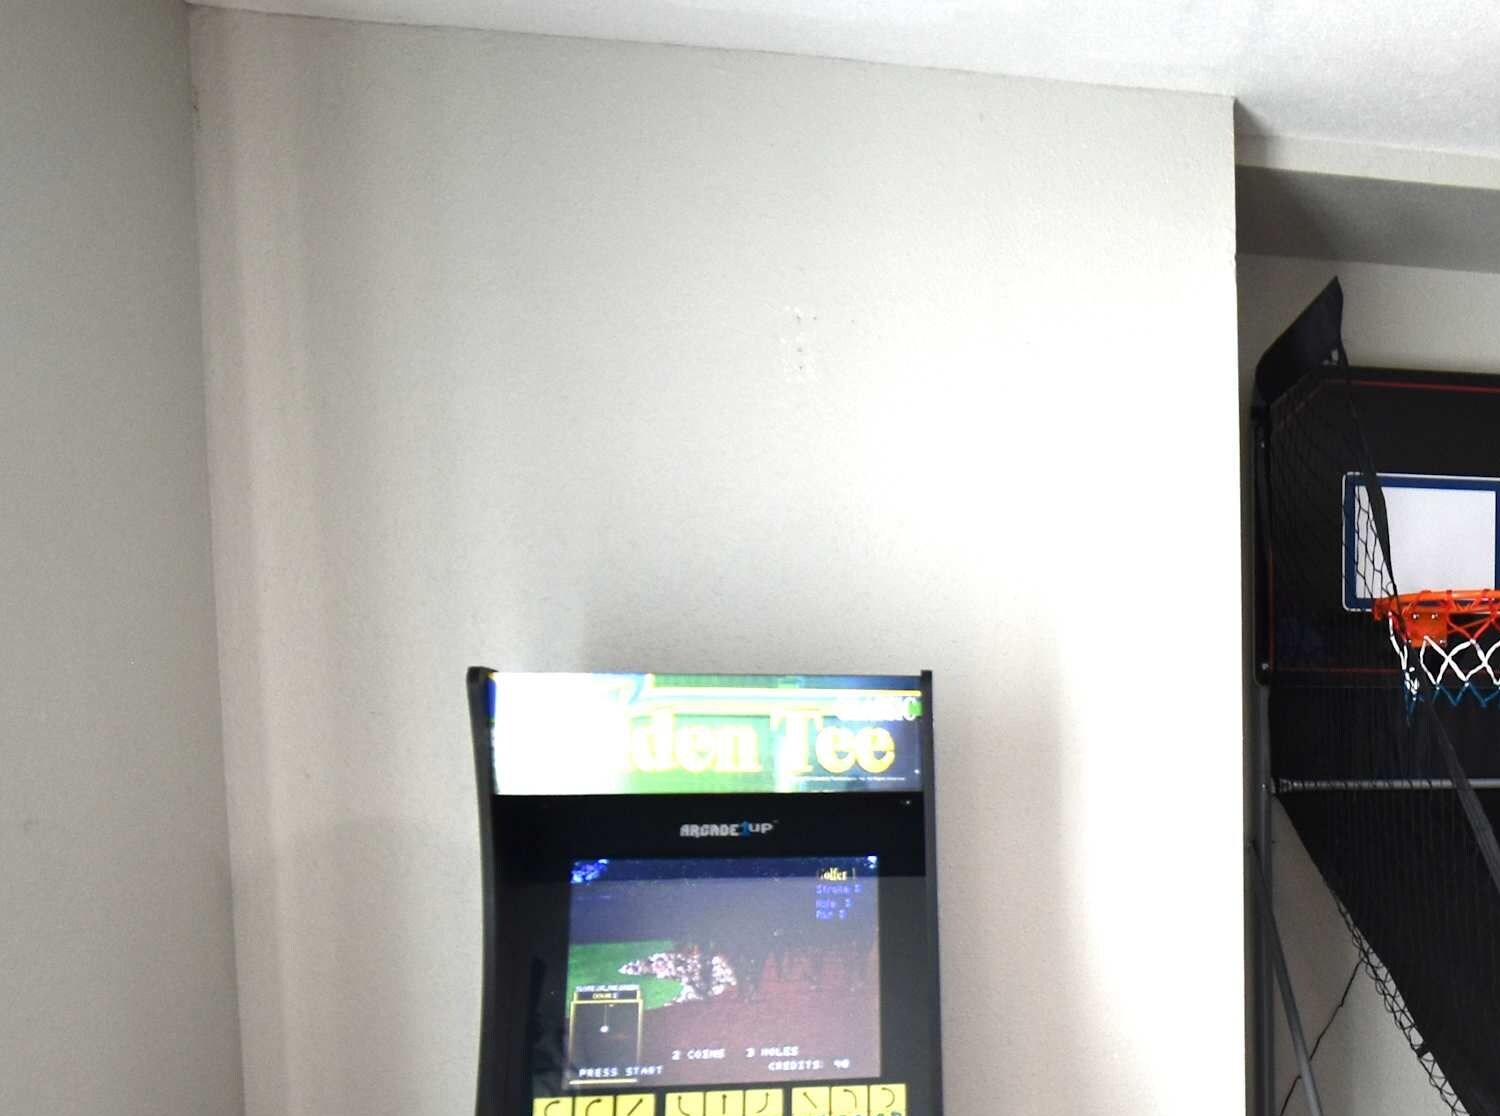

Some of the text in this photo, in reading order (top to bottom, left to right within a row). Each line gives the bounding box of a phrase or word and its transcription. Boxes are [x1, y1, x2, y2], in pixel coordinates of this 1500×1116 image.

[769, 707, 896, 774] Tee
[760, 1046, 799, 1057] HOLES
[579, 1065, 664, 1078] PRESS START
